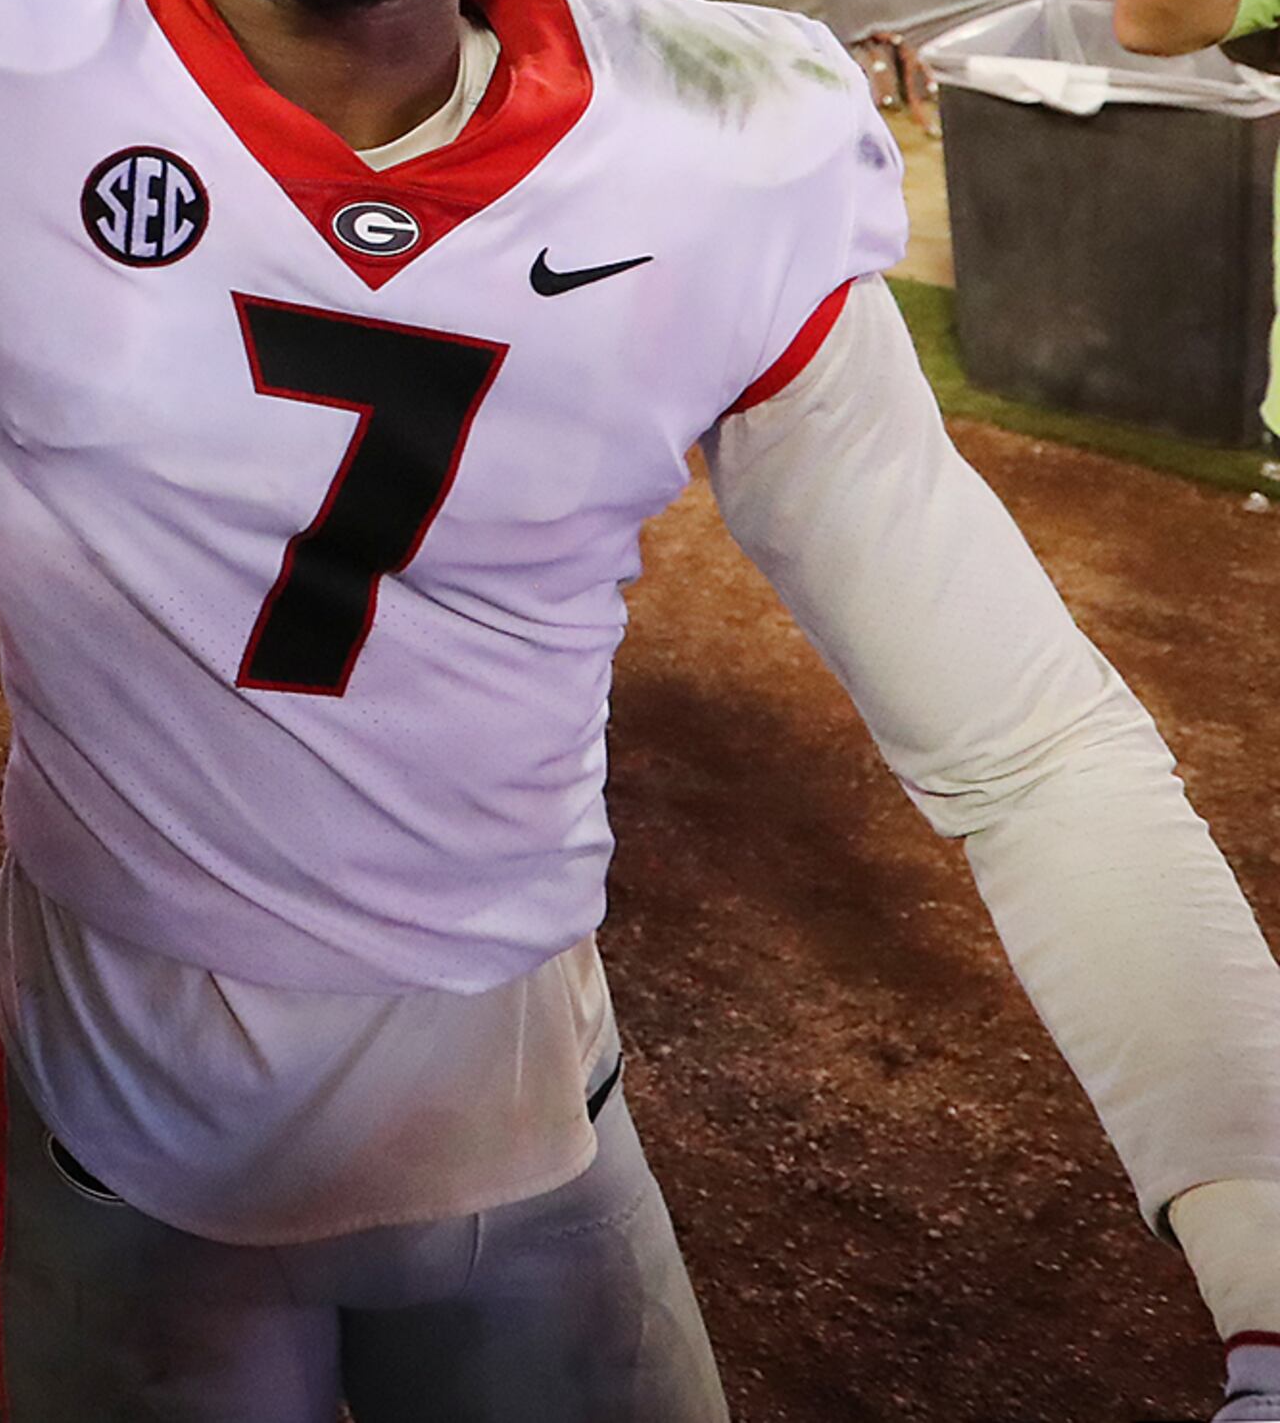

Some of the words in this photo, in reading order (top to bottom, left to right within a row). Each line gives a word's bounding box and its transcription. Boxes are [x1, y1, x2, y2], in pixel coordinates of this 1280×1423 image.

[94, 154, 197, 258] SEC
[332, 202, 420, 257] G
[230, 289, 511, 698] 7
